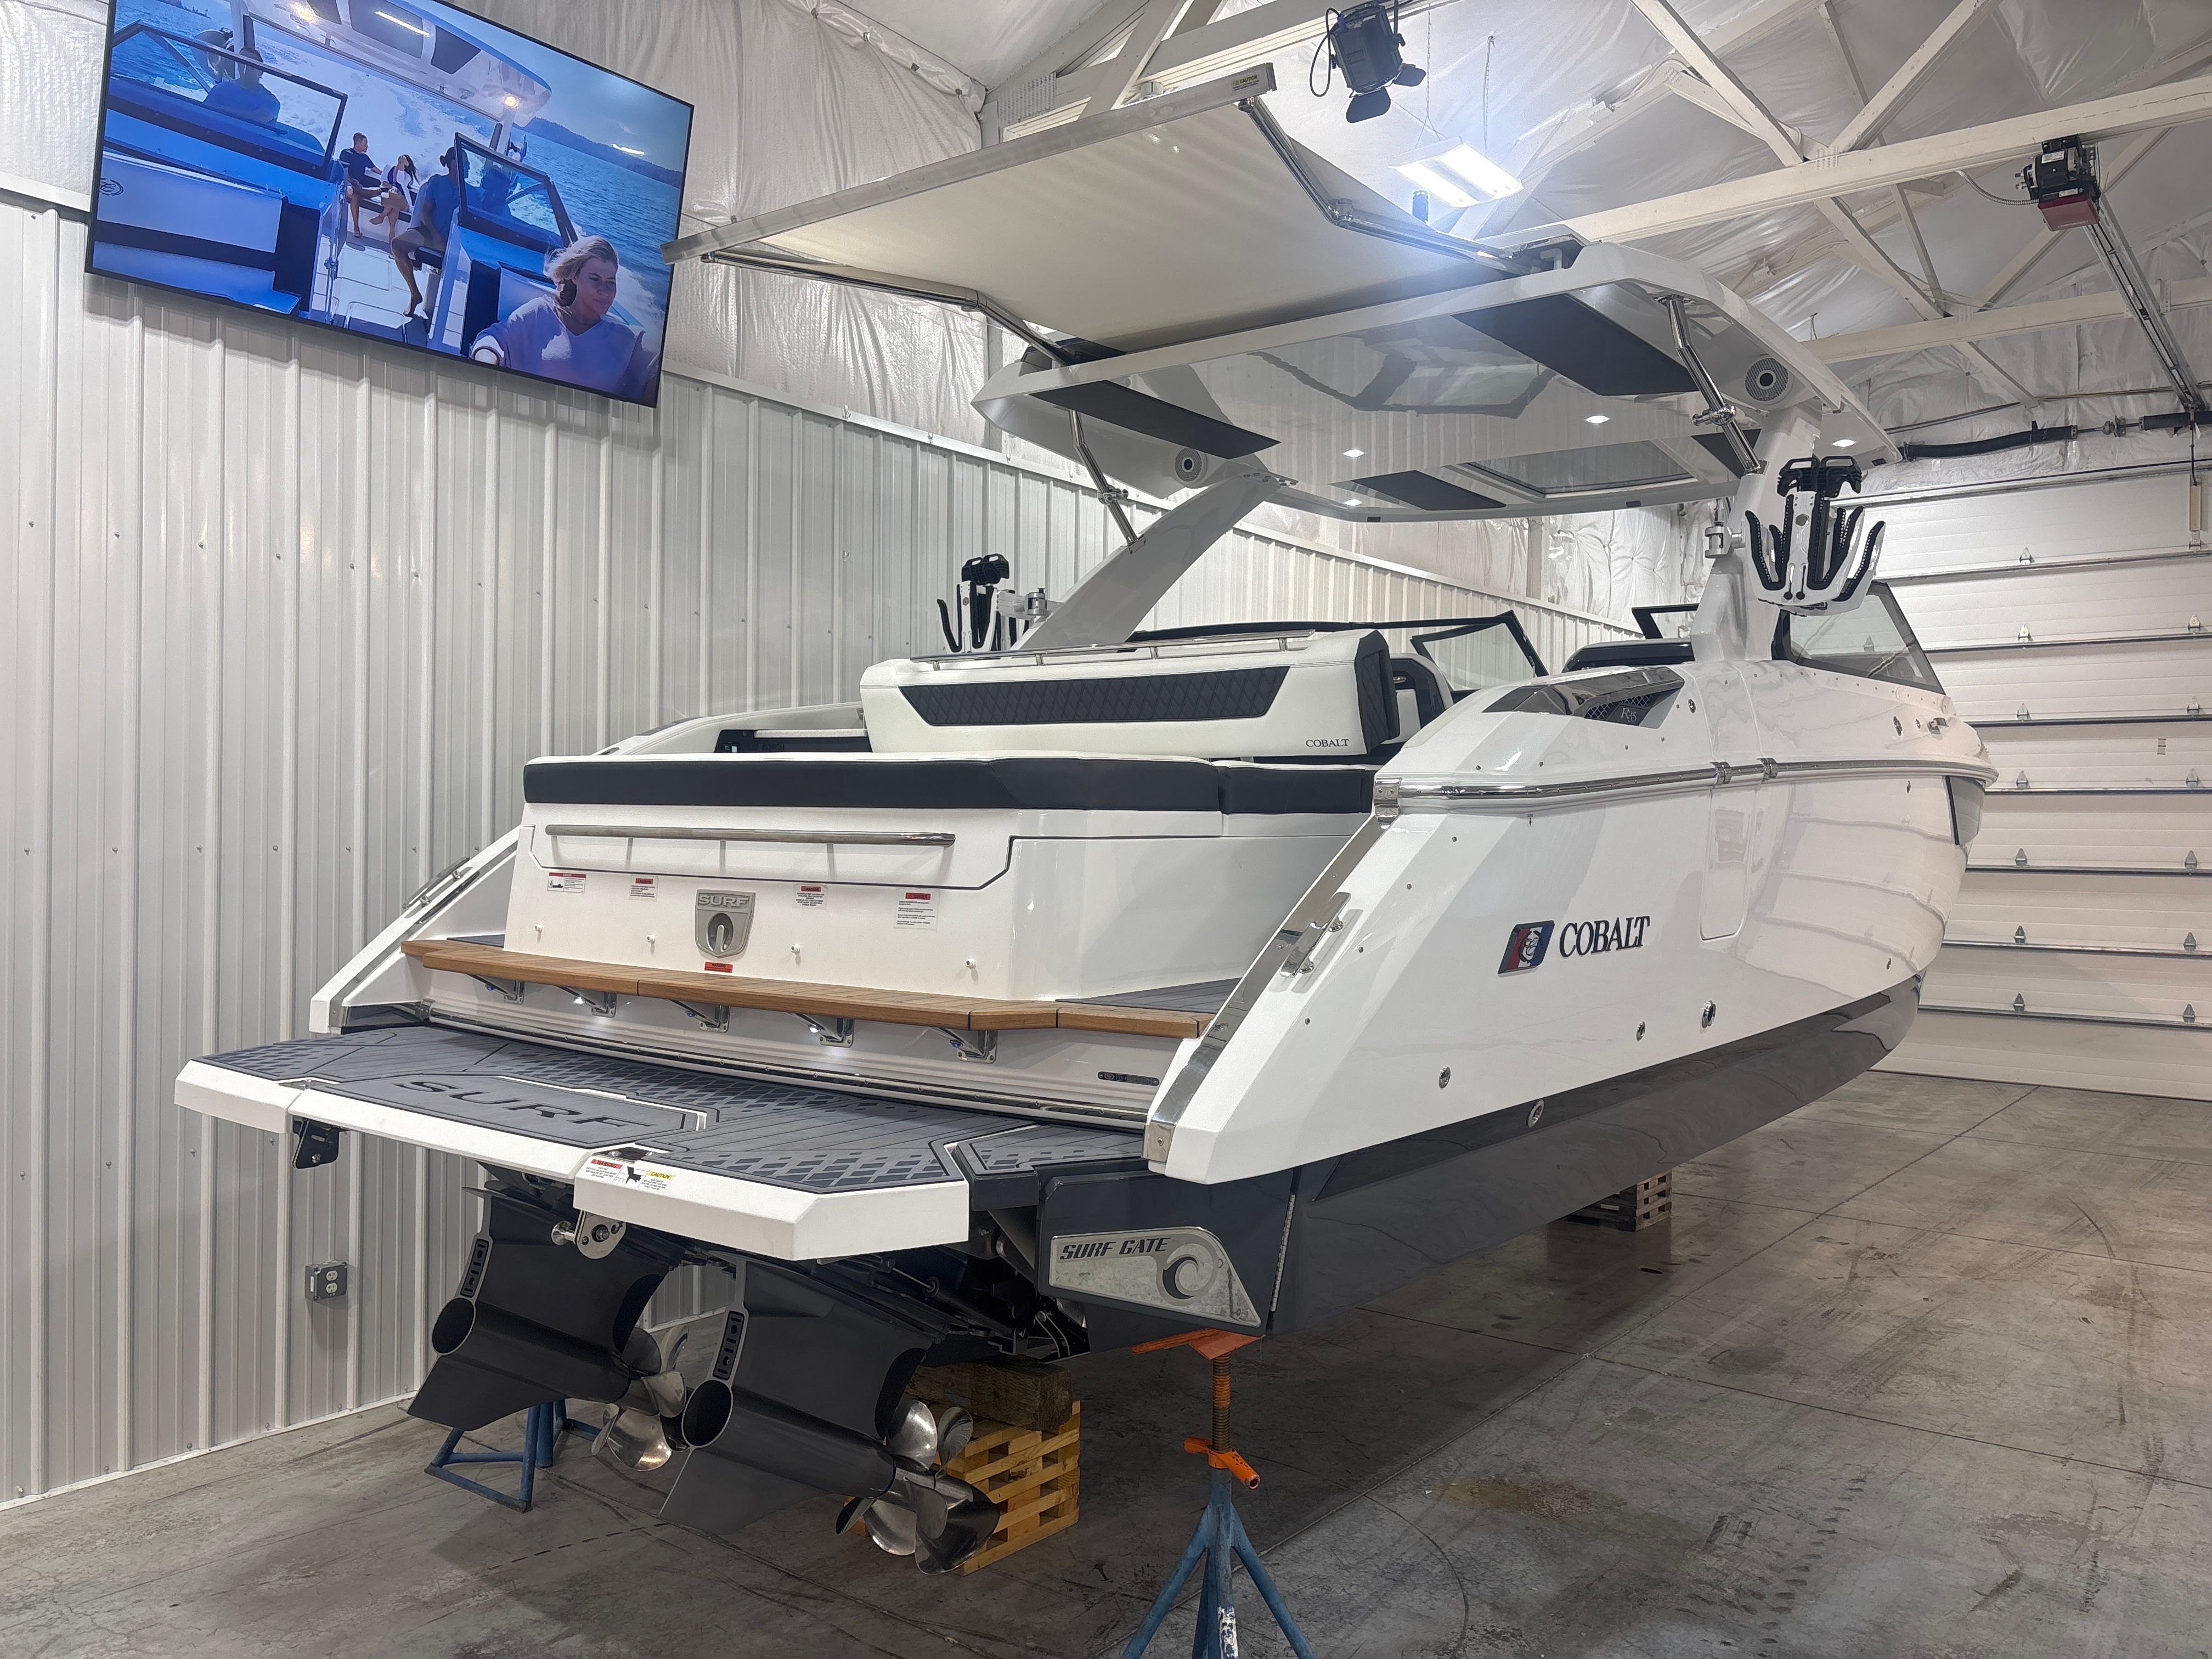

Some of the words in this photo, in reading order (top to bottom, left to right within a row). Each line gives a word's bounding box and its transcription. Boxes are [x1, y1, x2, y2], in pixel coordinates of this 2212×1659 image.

[1239, 75, 1257, 83] CAUTION
[1621, 707, 1637, 723] R35
[1306, 738, 1350, 747] COBALT
[698, 895, 749, 907] SURF
[1559, 916, 1650, 958] COBALT
[395, 1081, 658, 1127] SURF
[1059, 1242, 1117, 1260] SURF
[1119, 1237, 1171, 1255] GATE
